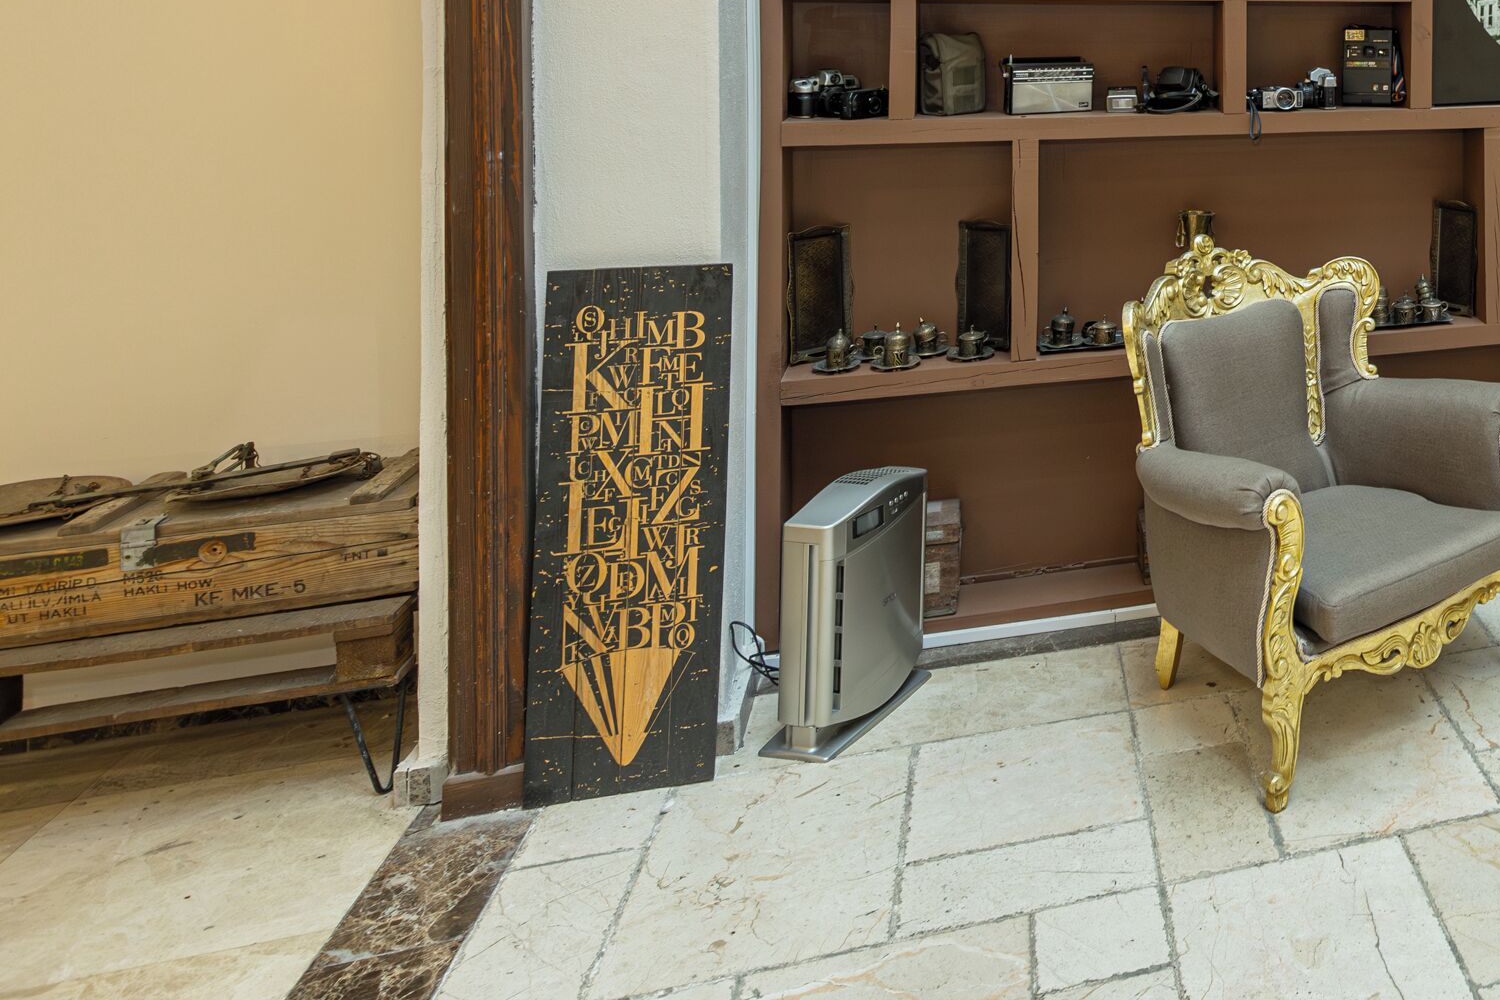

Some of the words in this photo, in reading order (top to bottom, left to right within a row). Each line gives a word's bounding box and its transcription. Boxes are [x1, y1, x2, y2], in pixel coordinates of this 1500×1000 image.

[646, 319, 676, 346] M
[671, 310, 706, 350] B
[676, 352, 704, 384] E
[654, 391, 677, 416] L
[38, 606, 87, 620] HAKLI
